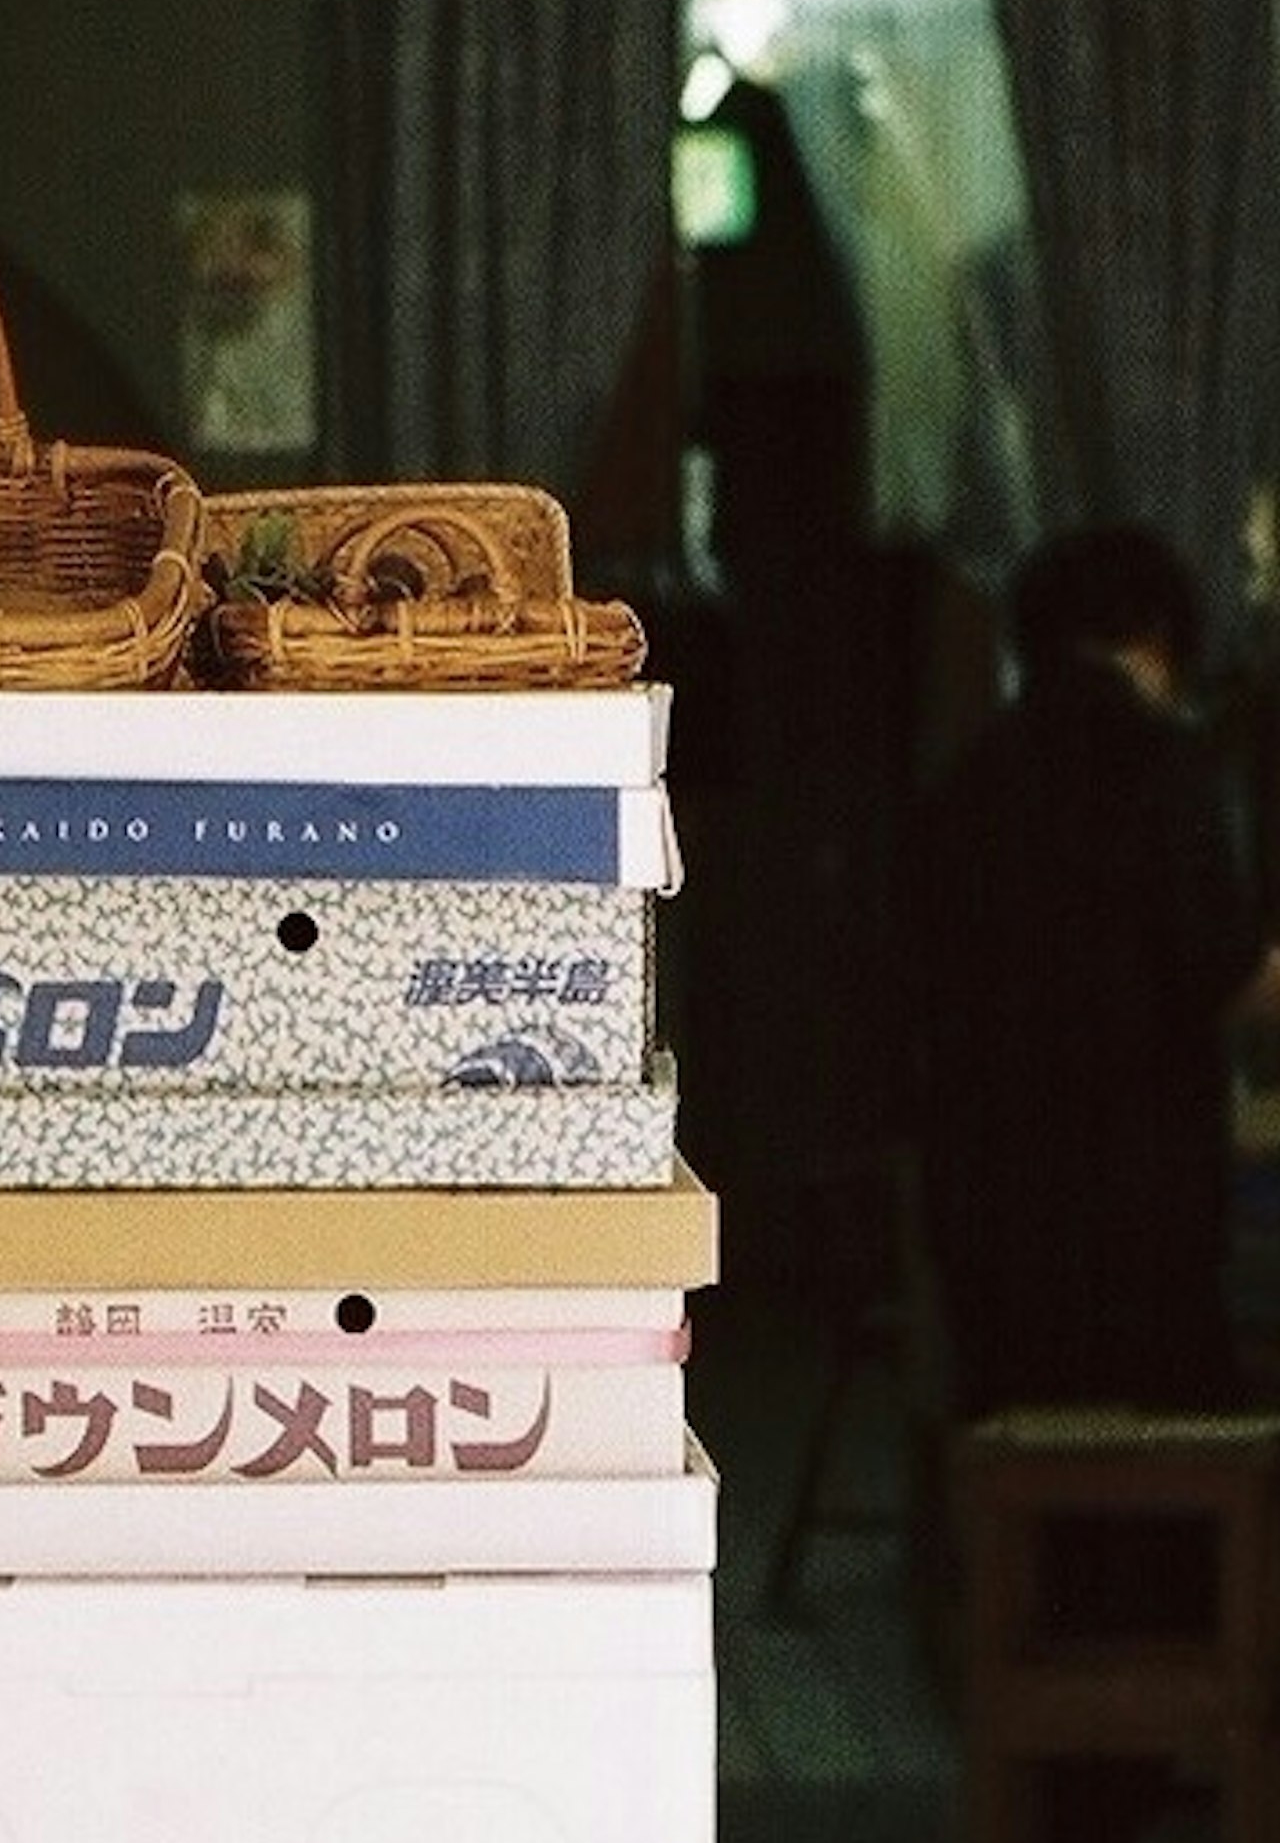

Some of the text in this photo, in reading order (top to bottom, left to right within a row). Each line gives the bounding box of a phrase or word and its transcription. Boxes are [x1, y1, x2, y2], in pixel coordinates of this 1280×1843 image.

[195, 817, 401, 843] FURANO
[404, 951, 610, 1006] 渥美半島
